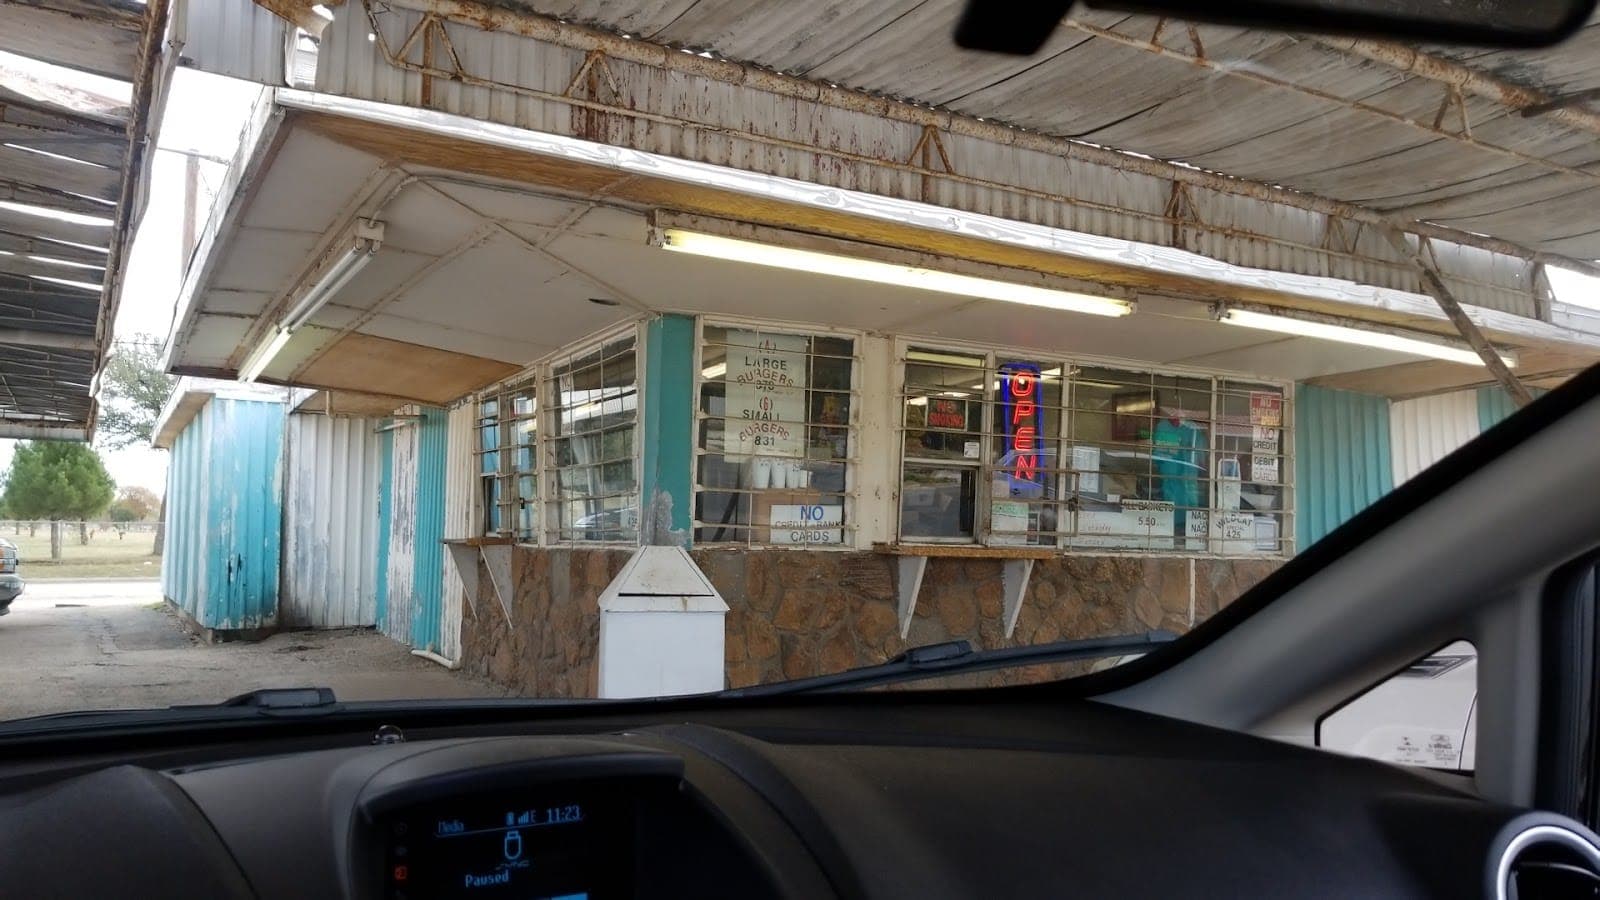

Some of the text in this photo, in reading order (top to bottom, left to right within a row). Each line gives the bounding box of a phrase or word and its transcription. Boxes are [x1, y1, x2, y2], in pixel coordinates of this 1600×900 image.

[744, 356, 787, 370] LARGE
[736, 368, 794, 388] BURGERS
[742, 409, 780, 422] SMALL
[739, 422, 790, 442] BURGERS
[1011, 371, 1036, 480] OPEN
[1260, 426, 1275, 440] NO
[754, 435, 775, 446] 831
[1253, 440, 1276, 450] CREDIT
[1255, 455, 1275, 466] DEBIT
[800, 505, 824, 521] NO
[791, 531, 830, 543] CARDS
[546, 805, 582, 824] 11:23
[465, 871, 509, 887] Paused
